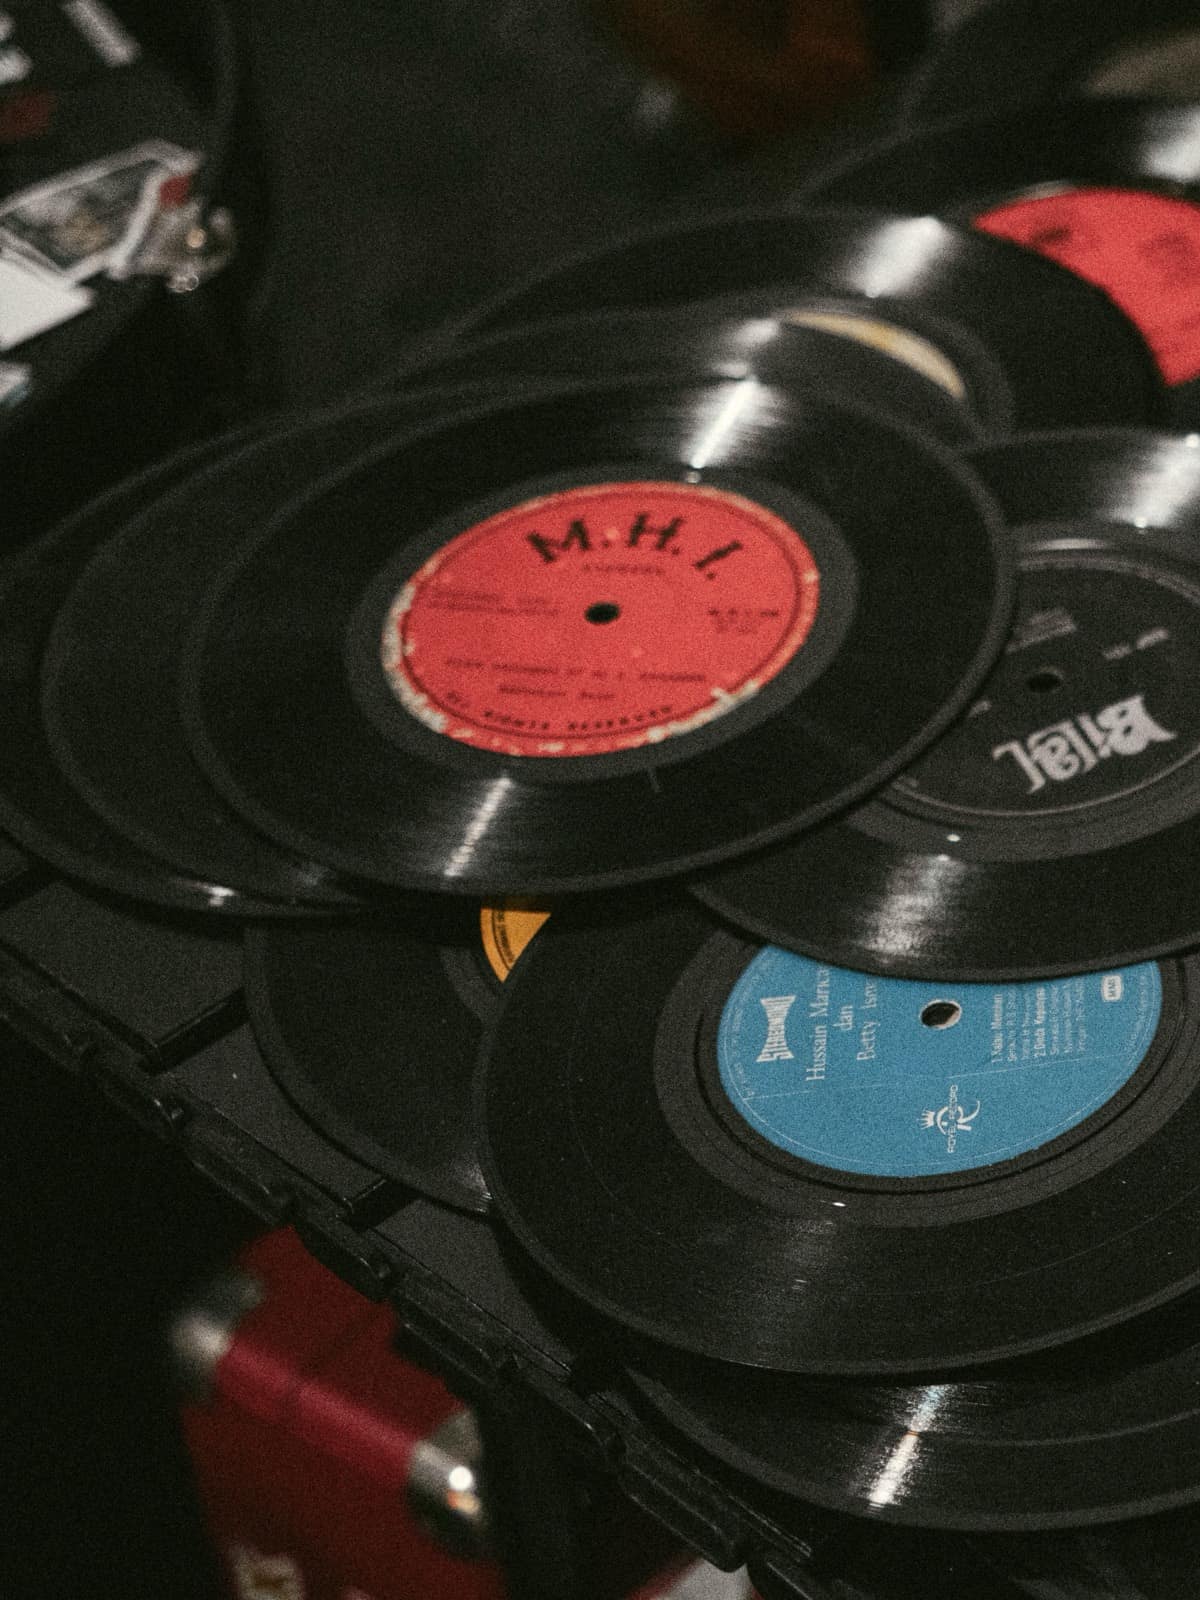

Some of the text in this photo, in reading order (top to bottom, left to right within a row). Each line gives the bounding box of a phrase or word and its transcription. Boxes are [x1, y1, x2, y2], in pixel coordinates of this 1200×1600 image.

[833, 1005, 854, 1031] dan
[805, 1025, 828, 1081] Hussain
[857, 1020, 881, 1061] Betty
